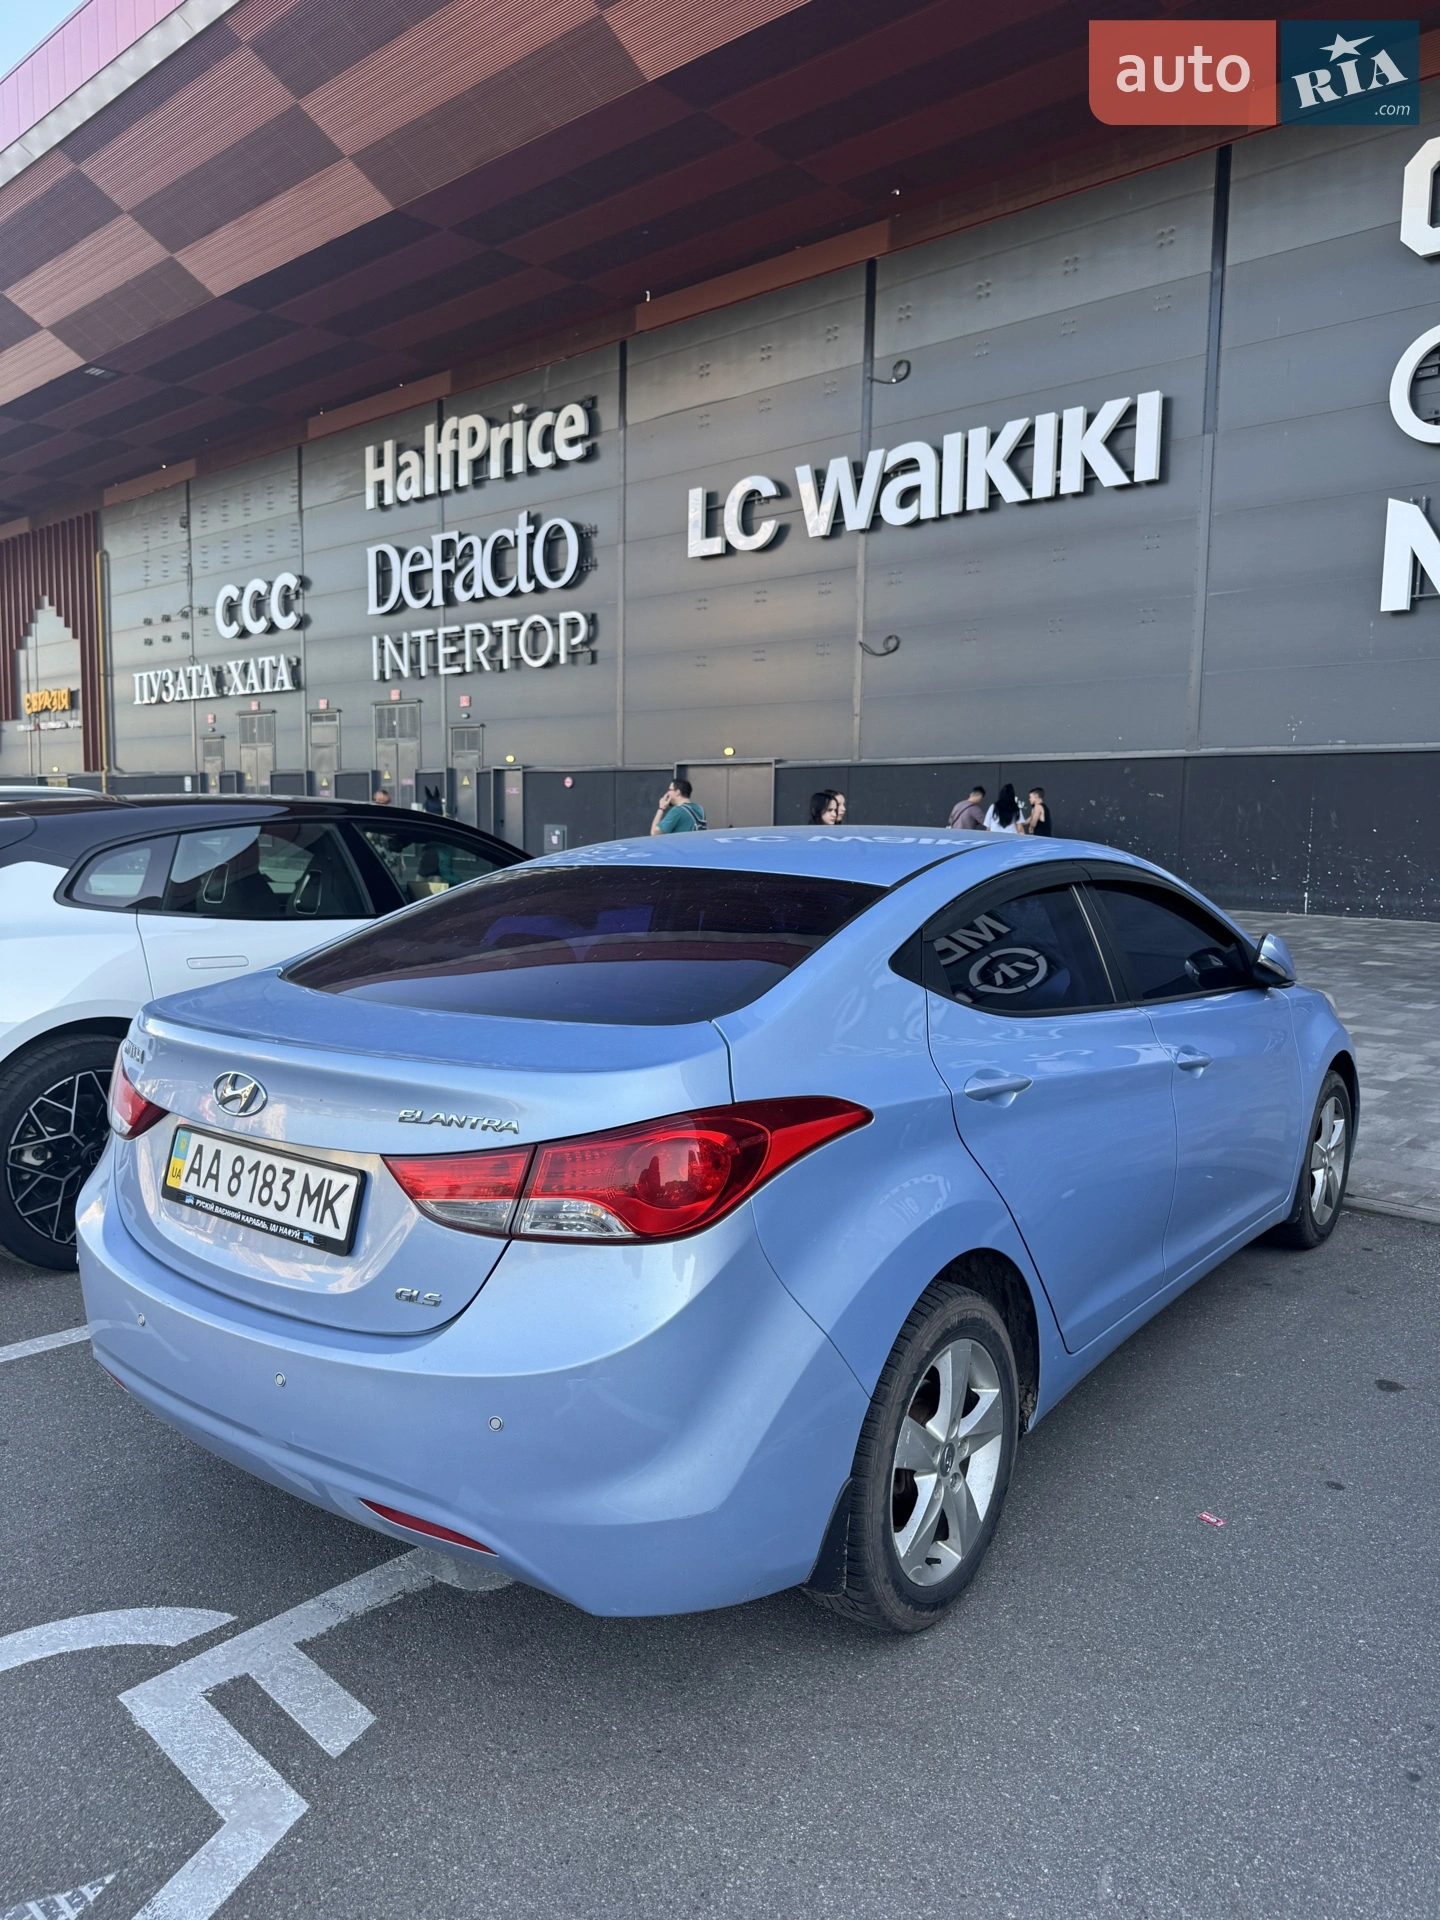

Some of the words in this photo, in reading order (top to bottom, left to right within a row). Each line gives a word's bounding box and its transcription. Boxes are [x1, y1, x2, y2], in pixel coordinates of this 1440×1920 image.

[365, 403, 589, 510] HalfPrice
[687, 474, 781, 559] LC
[366, 510, 579, 615] DeFacto
[215, 572, 301, 639] CCC
[132, 663, 217, 705] ПУЗАТА
[226, 653, 297, 697] ХАТА
[371, 610, 589, 681] INTERTOP
[398, 1108, 521, 1135] ELANTRA
[171, 1166, 182, 1180] UA
[184, 1144, 221, 1194] AA
[226, 1155, 296, 1213] 8183
[296, 1176, 350, 1231] MK
[395, 1287, 443, 1308] GLS
